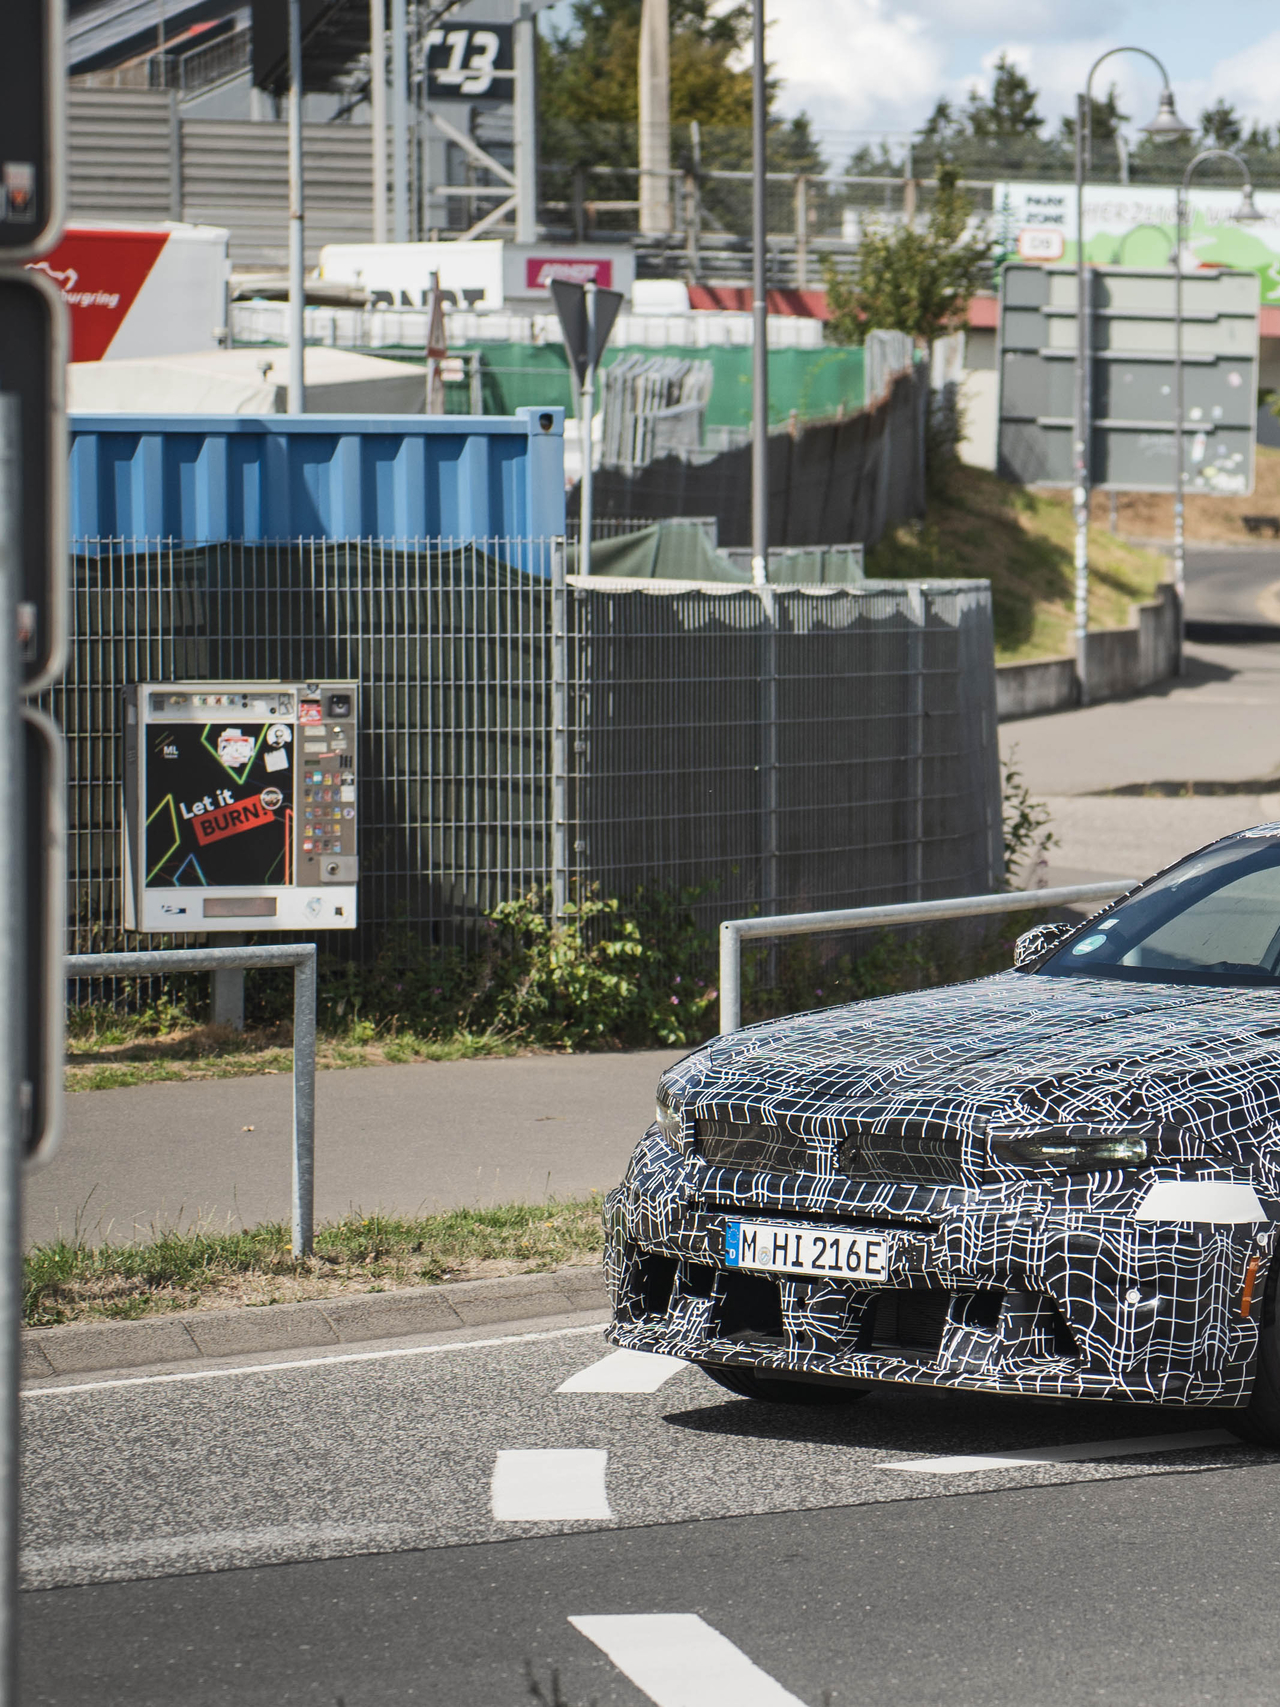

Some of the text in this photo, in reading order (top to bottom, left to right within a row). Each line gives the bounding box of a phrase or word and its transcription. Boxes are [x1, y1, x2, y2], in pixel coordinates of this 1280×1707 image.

[1027, 213, 1064, 224] ZONE
[61, 289, 120, 309] burgring
[179, 788, 234, 819] Let it
[729, 1248, 736, 1259] D
[742, 1230, 882, 1275] M HI 216E
